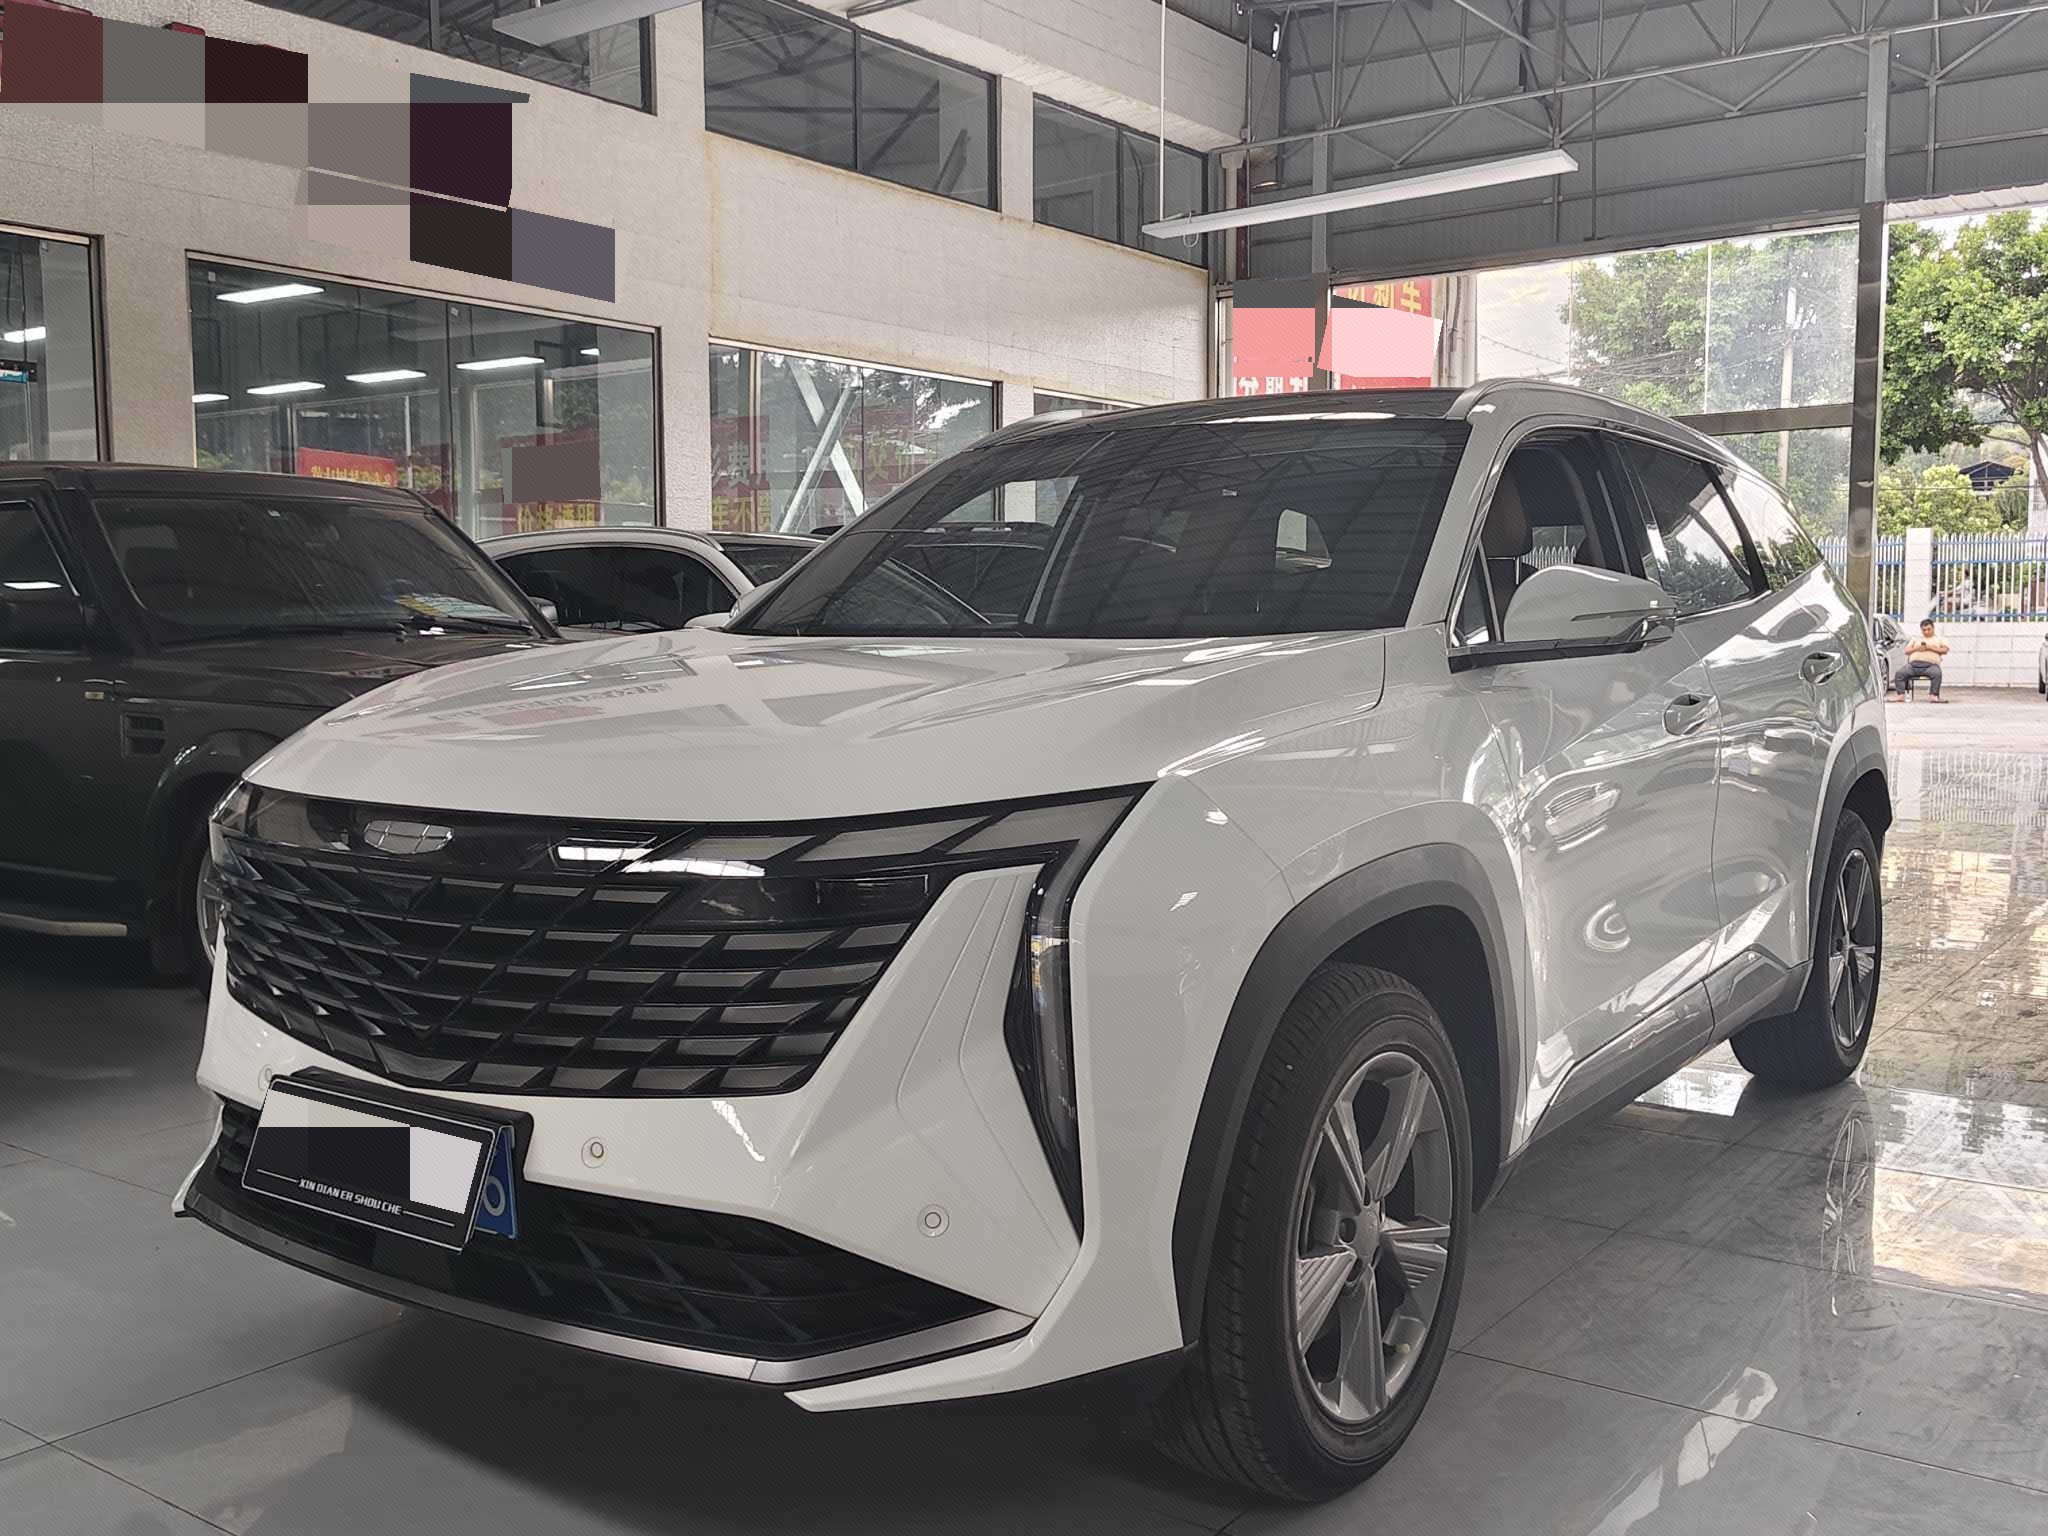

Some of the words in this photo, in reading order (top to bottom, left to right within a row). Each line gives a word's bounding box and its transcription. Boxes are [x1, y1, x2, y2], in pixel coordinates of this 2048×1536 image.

[298, 1178, 316, 1191] XIN
[316, 1183, 340, 1198] DIAN
[340, 1190, 354, 1202] ER
[354, 1194, 382, 1209] SHOU
[381, 1201, 402, 1215] CHE
